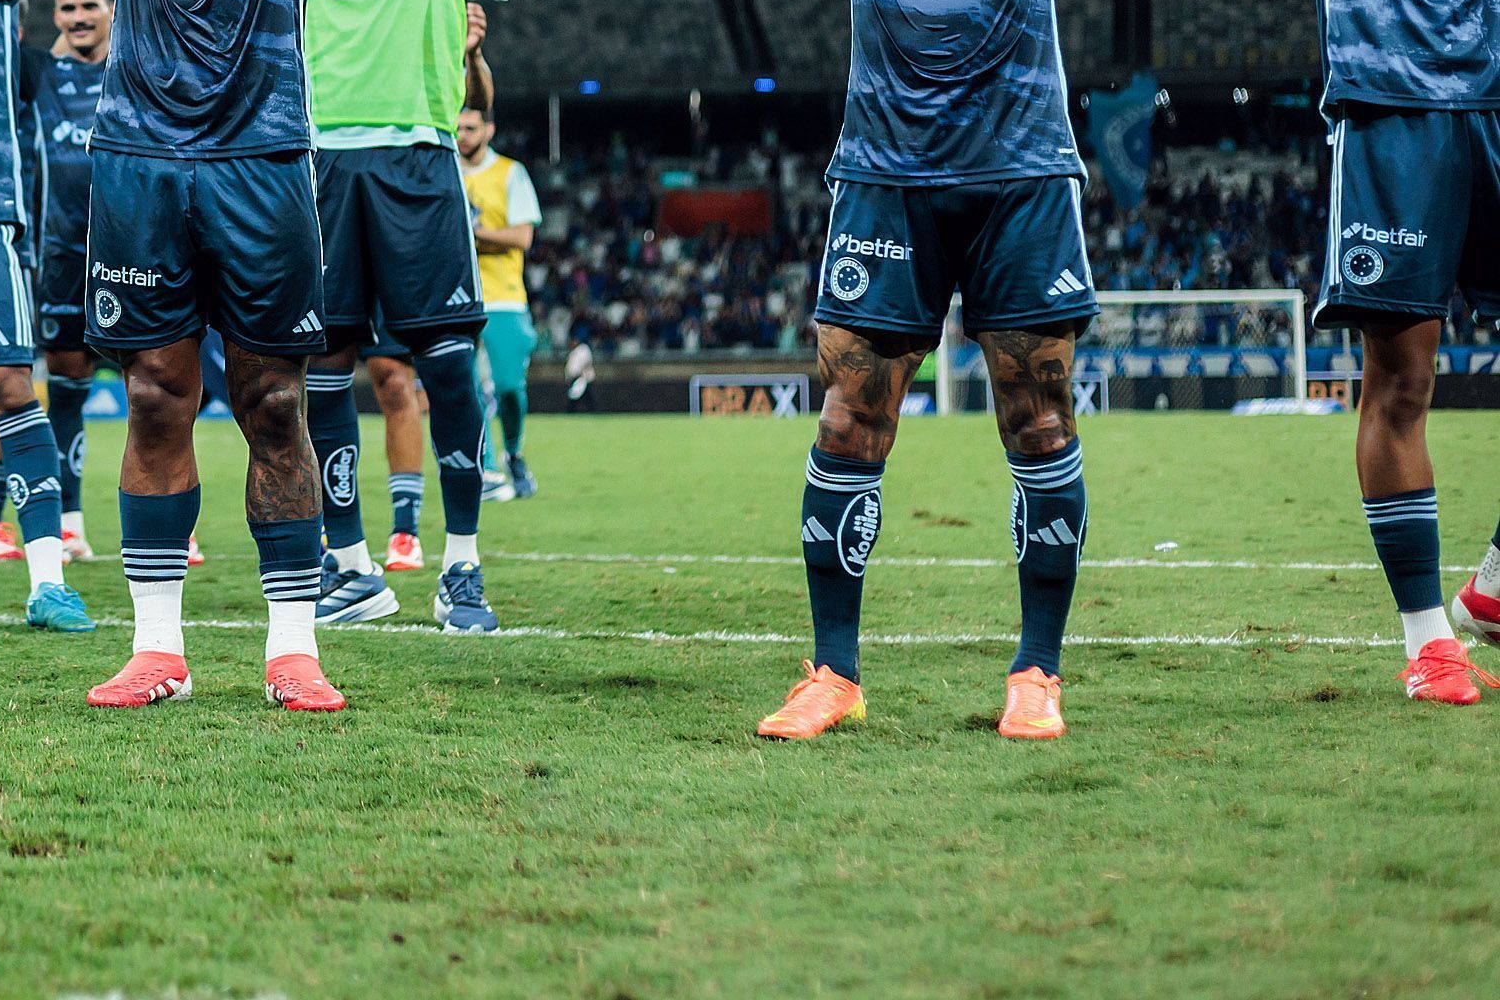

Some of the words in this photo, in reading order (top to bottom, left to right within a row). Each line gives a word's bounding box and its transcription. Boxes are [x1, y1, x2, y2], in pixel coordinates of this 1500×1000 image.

[846, 234, 913, 260] betfair
[1362, 223, 1428, 247] betfair
[100, 263, 162, 286] betfair
[701, 384, 798, 418] BRAX
[332, 449, 353, 498] Kodilar
[847, 495, 879, 566] Kodilar
